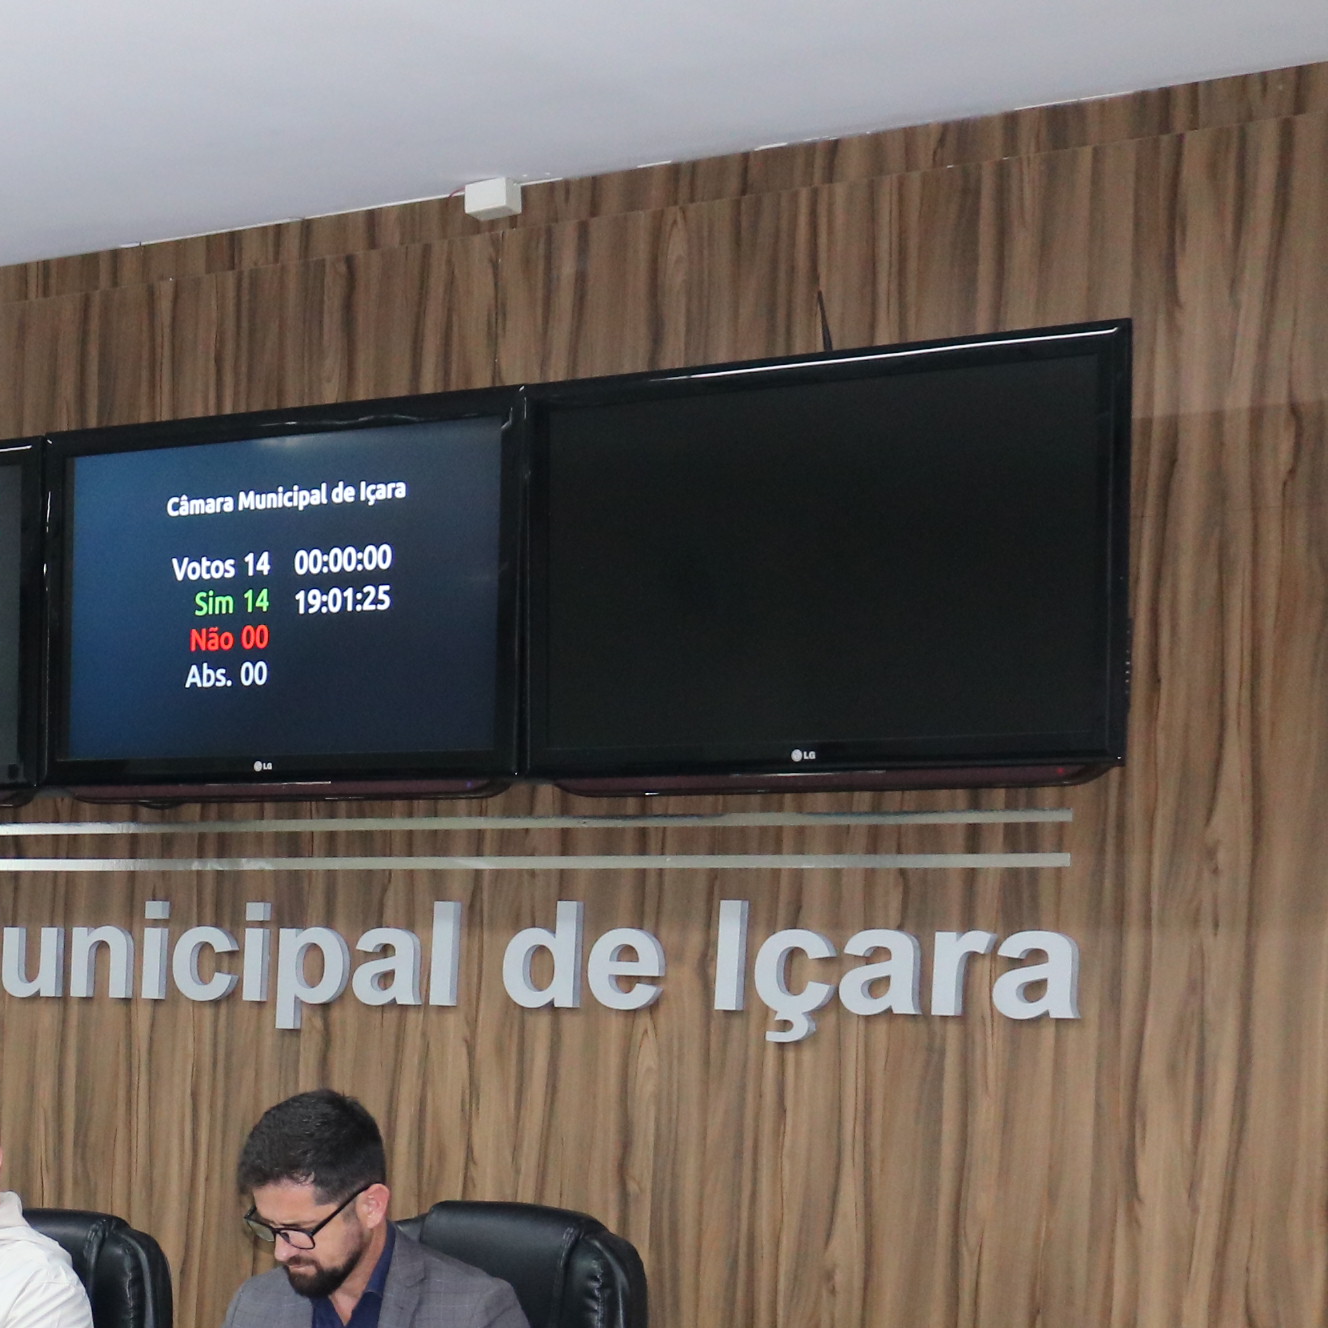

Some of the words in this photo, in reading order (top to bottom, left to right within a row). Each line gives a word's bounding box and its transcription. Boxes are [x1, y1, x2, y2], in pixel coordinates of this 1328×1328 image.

[166, 494, 234, 517] Câmara
[238, 482, 328, 511] Municipal
[331, 480, 356, 504] de
[360, 480, 407, 506] Içara
[171, 556, 236, 581] Votos
[244, 551, 271, 577] 14
[294, 543, 393, 575] 00:00:00
[194, 590, 234, 616] Sim
[243, 588, 270, 613] 14
[295, 584, 391, 615] 19:01:25
[190, 626, 234, 652] Não
[241, 624, 269, 650] 00
[185, 662, 232, 688] Abs.
[240, 660, 268, 686] 00
[502, 901, 665, 1010] de
[714, 900, 1080, 1043] Içara
